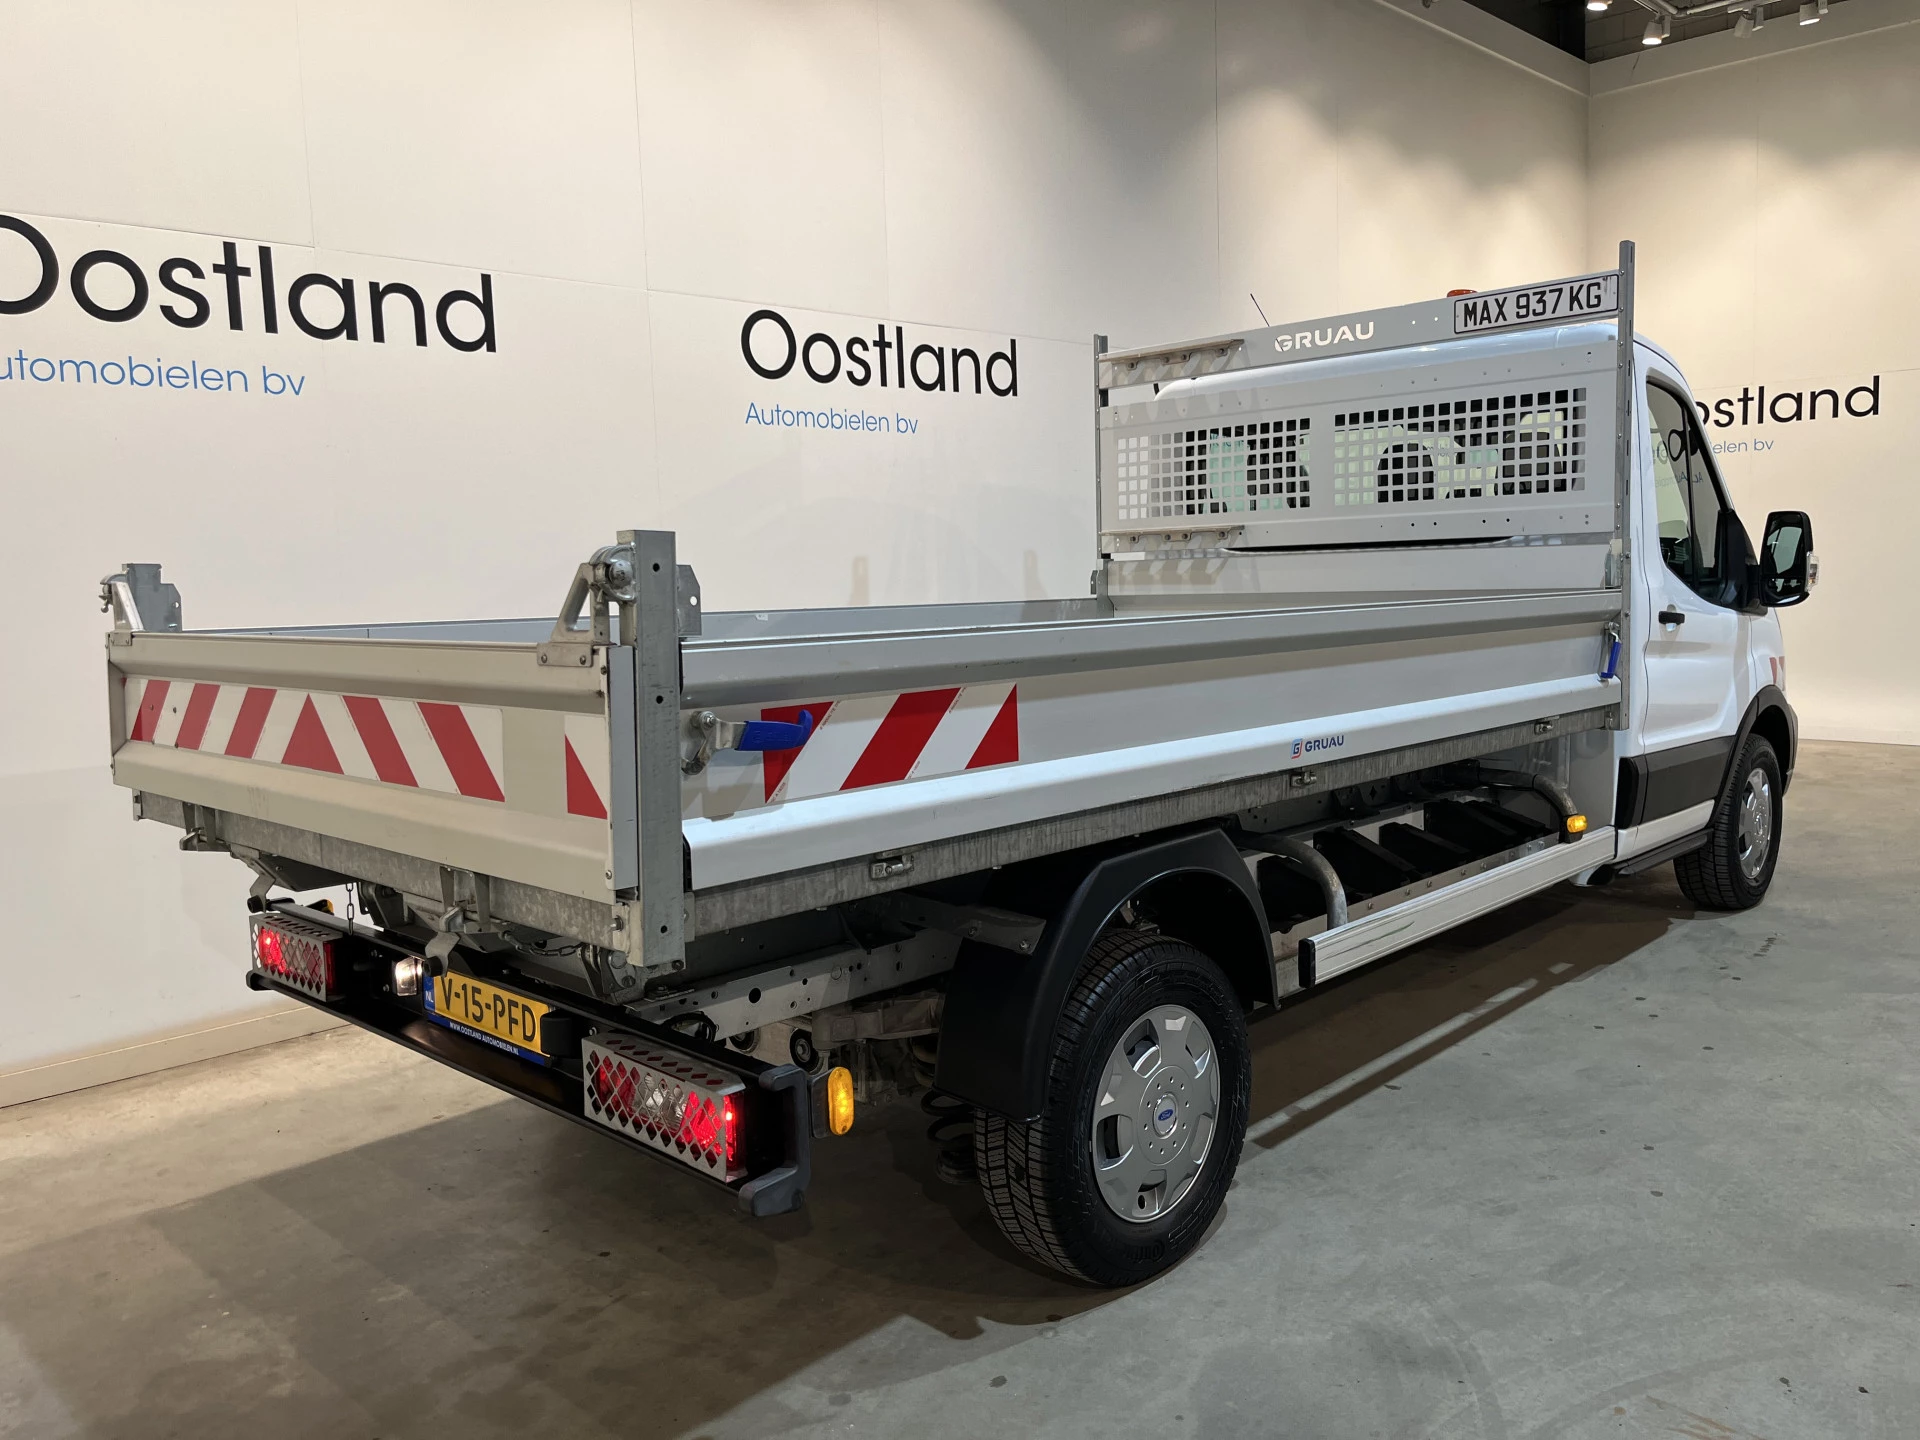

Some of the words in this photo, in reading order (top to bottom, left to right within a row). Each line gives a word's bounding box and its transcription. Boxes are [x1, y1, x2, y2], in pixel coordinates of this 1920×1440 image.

[1463, 296, 1508, 328] MAX
[1515, 287, 1564, 320] 937
[1568, 281, 1602, 312] KG
[740, 309, 1018, 397] Oostland
[1274, 321, 1374, 352] GRUAU
[0, 349, 249, 393] utomobielen
[262, 366, 306, 396] bv
[745, 402, 890, 433] Automobielen
[896, 412, 919, 434] bv
[1697, 375, 1880, 428] stland
[1753, 438, 1775, 452] bv
[1304, 734, 1344, 753] GRUAU
[425, 990, 434, 1003] NL
[440, 975, 537, 1042] V-15-PFD
